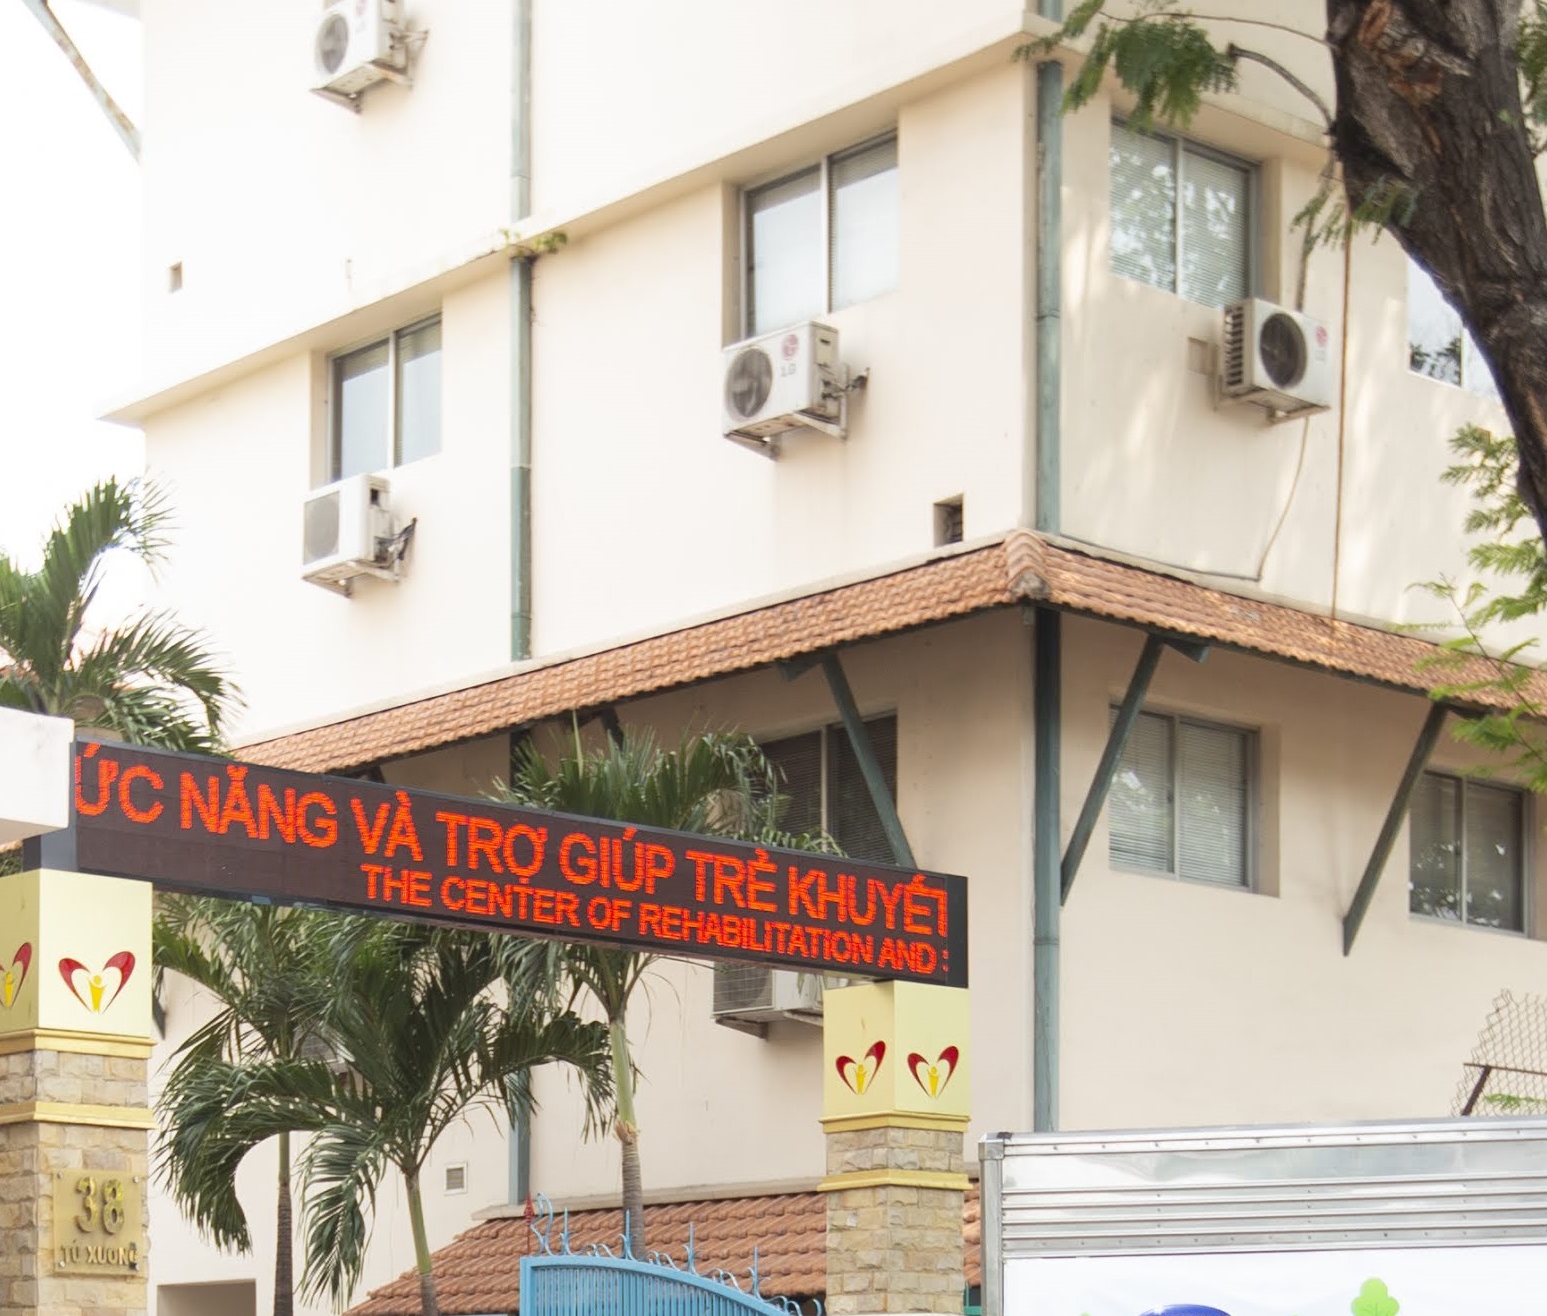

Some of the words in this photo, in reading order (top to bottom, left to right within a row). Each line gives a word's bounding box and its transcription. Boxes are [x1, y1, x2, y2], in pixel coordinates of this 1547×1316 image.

[180, 764, 338, 849] NĂNG
[351, 790, 424, 863] VÀ
[435, 811, 549, 886] TRỢ
[559, 826, 676, 896] GIÚP
[685, 848, 778, 914] TRẺ
[360, 862, 433, 909] THE
[440, 875, 580, 929] CENTER
[587, 894, 633, 933] OF
[638, 901, 875, 968] REHABILITATION
[877, 937, 939, 976] AND
[75, 1177, 126, 1236] 38
